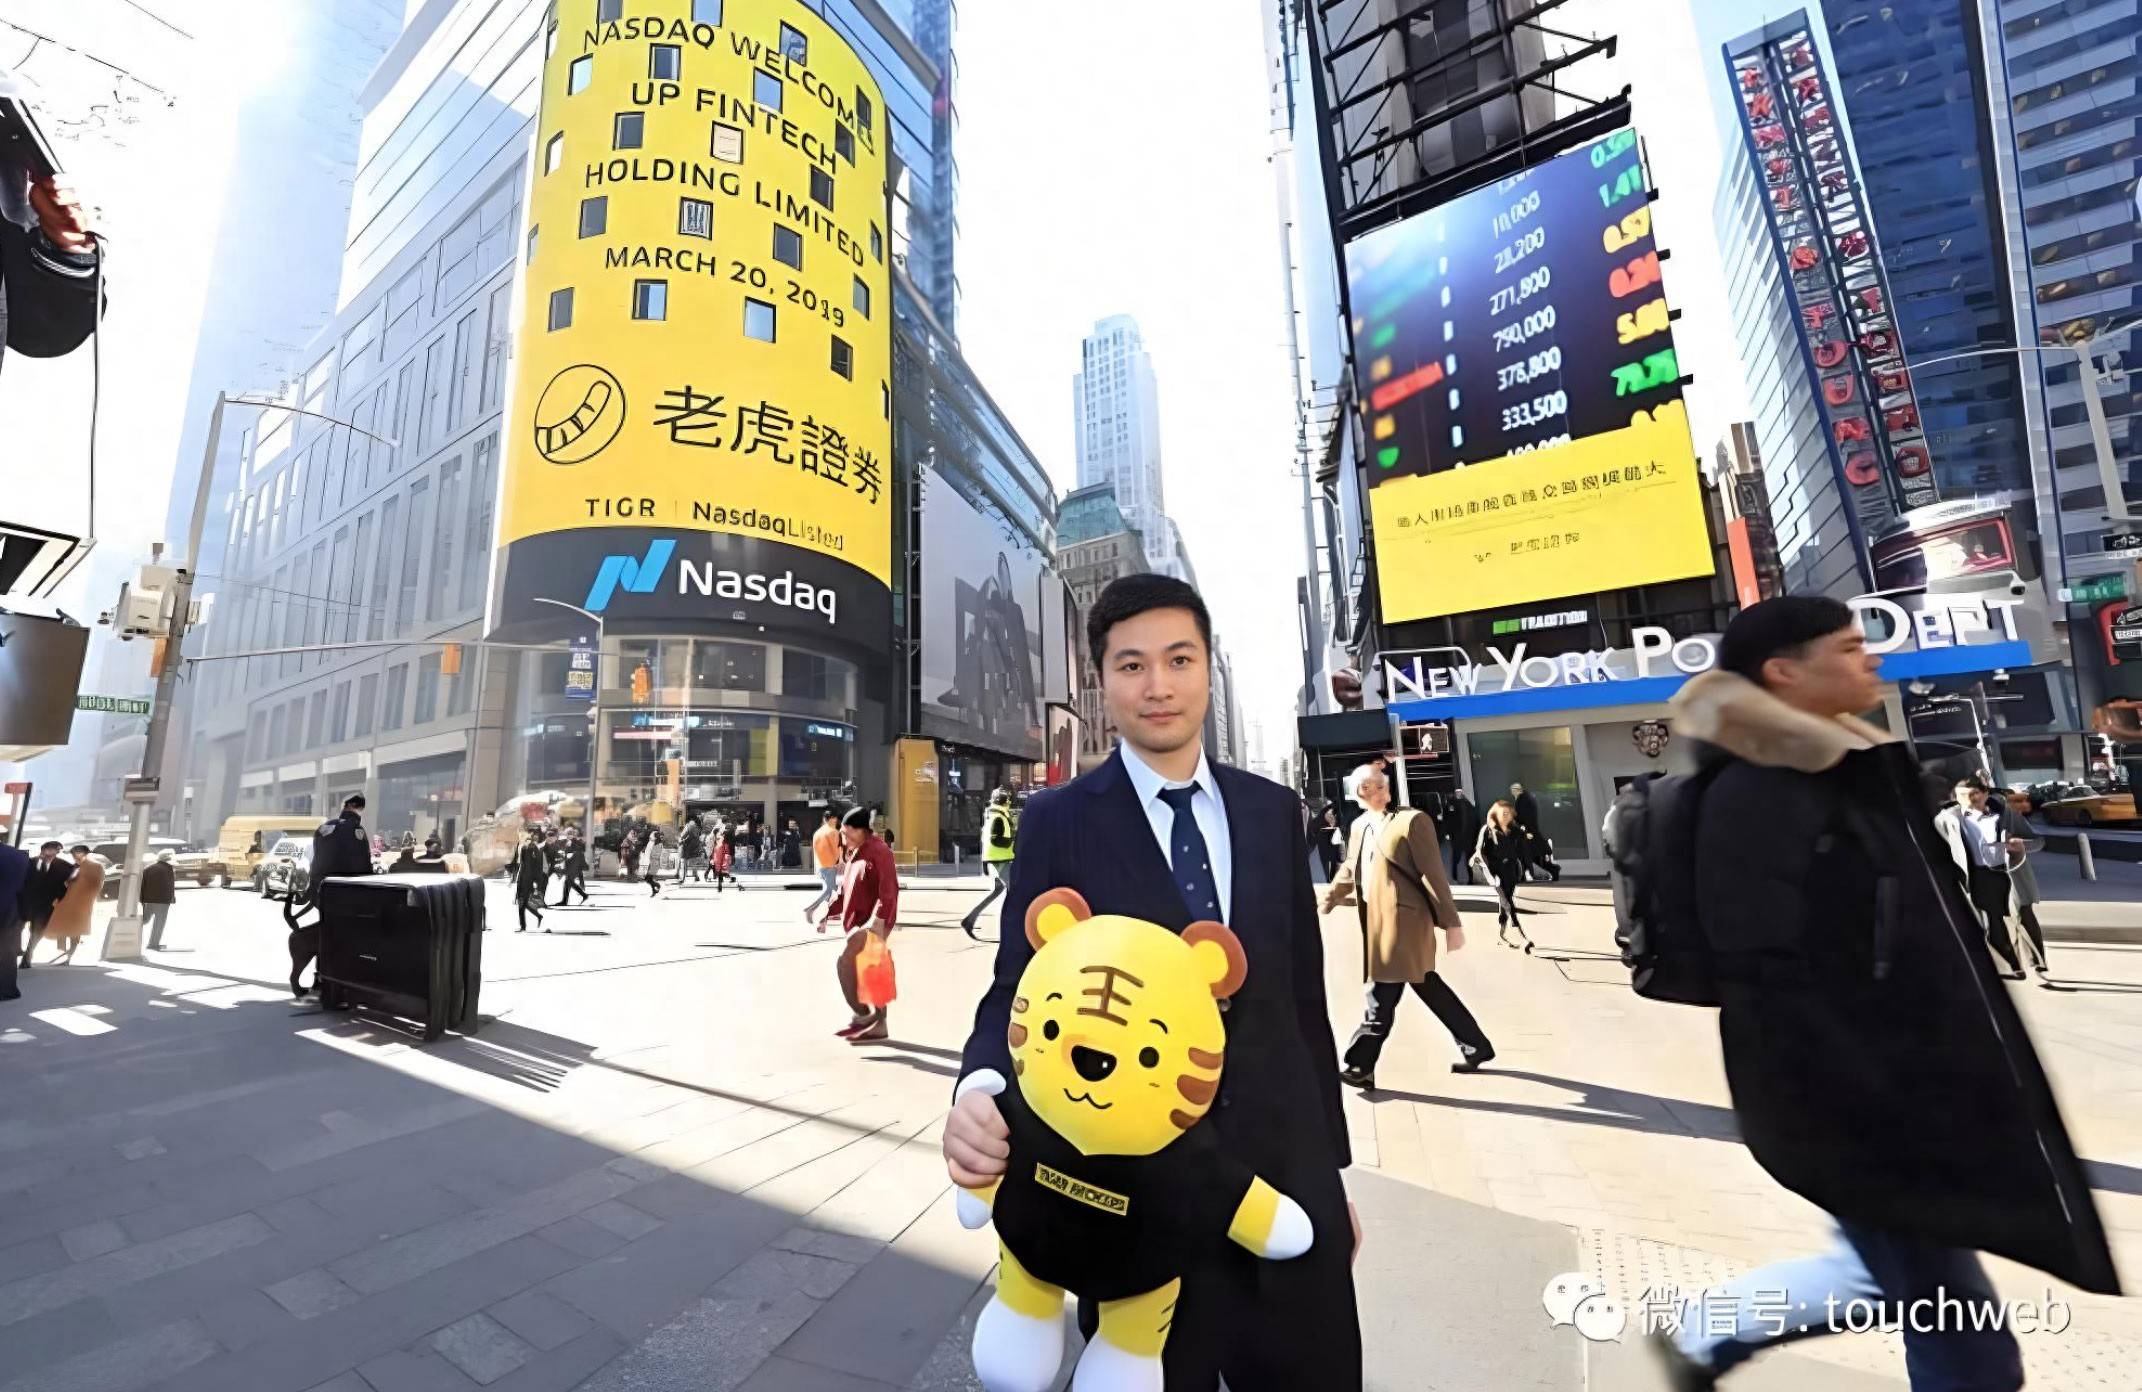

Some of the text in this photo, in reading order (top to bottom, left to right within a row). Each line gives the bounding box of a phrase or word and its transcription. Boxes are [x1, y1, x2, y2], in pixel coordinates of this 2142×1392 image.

[584, 16, 715, 53] NASDAQ
[632, 81, 837, 174] UP FINTECH
[585, 157, 864, 267] HOLDING LIMITED
[605, 246, 845, 328] MARCH 20, 2019
[653, 385, 882, 505] 老虎證券
[1502, 389, 1568, 431] 333,500
[586, 497, 656, 518] TIGR
[679, 559, 836, 624] Nasdaq
